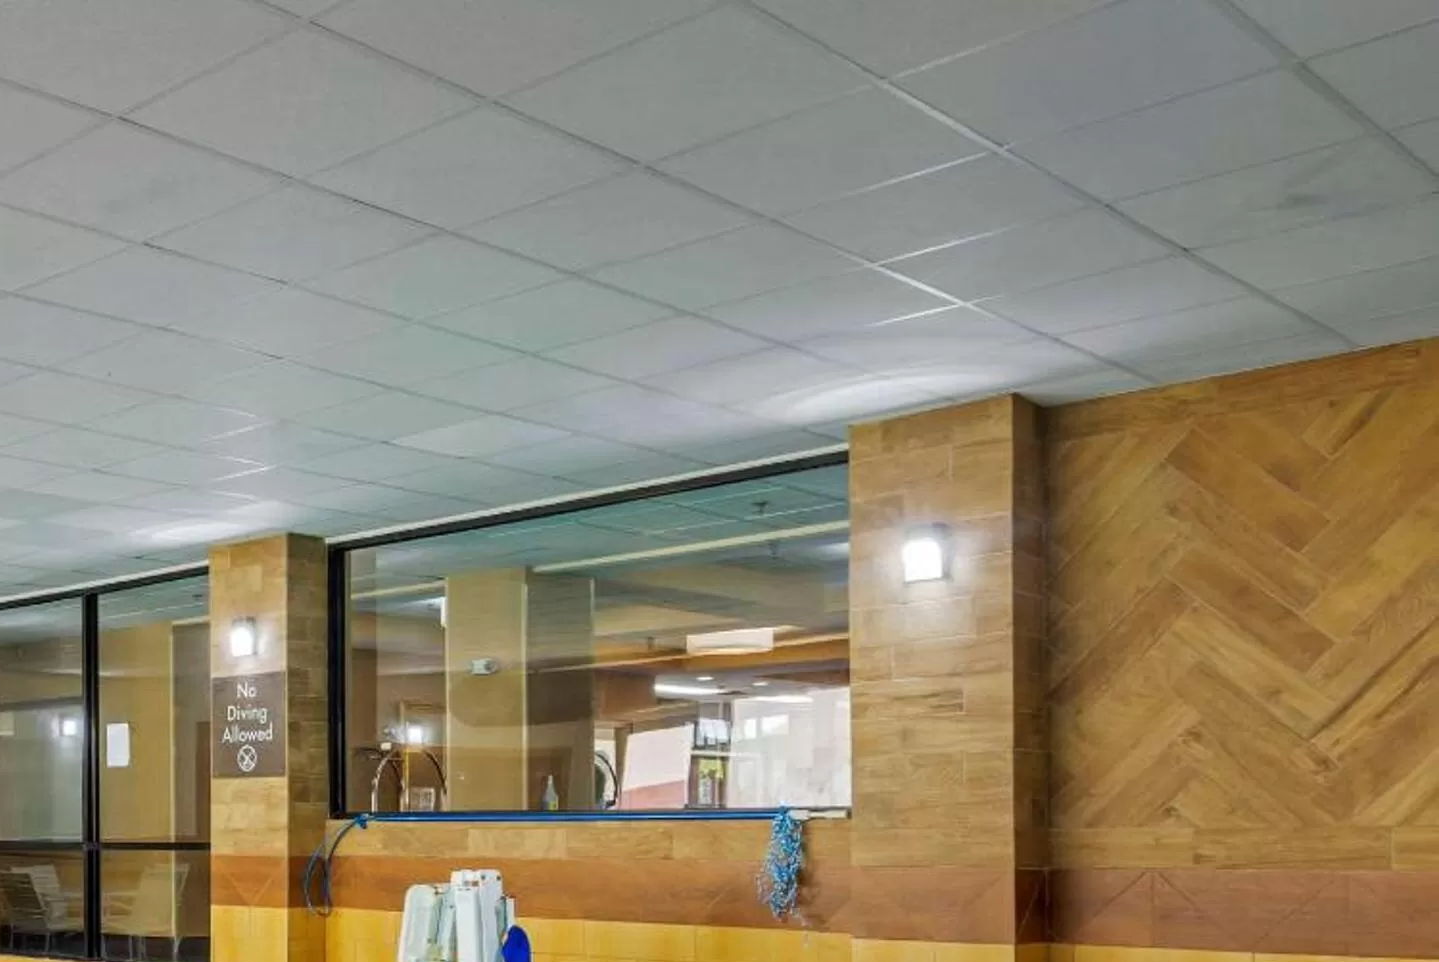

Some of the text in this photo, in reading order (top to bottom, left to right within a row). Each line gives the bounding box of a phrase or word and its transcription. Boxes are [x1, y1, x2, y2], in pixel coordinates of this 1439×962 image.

[236, 681, 257, 698] No
[227, 704, 268, 724] Diving
[221, 721, 273, 743] Allowed
